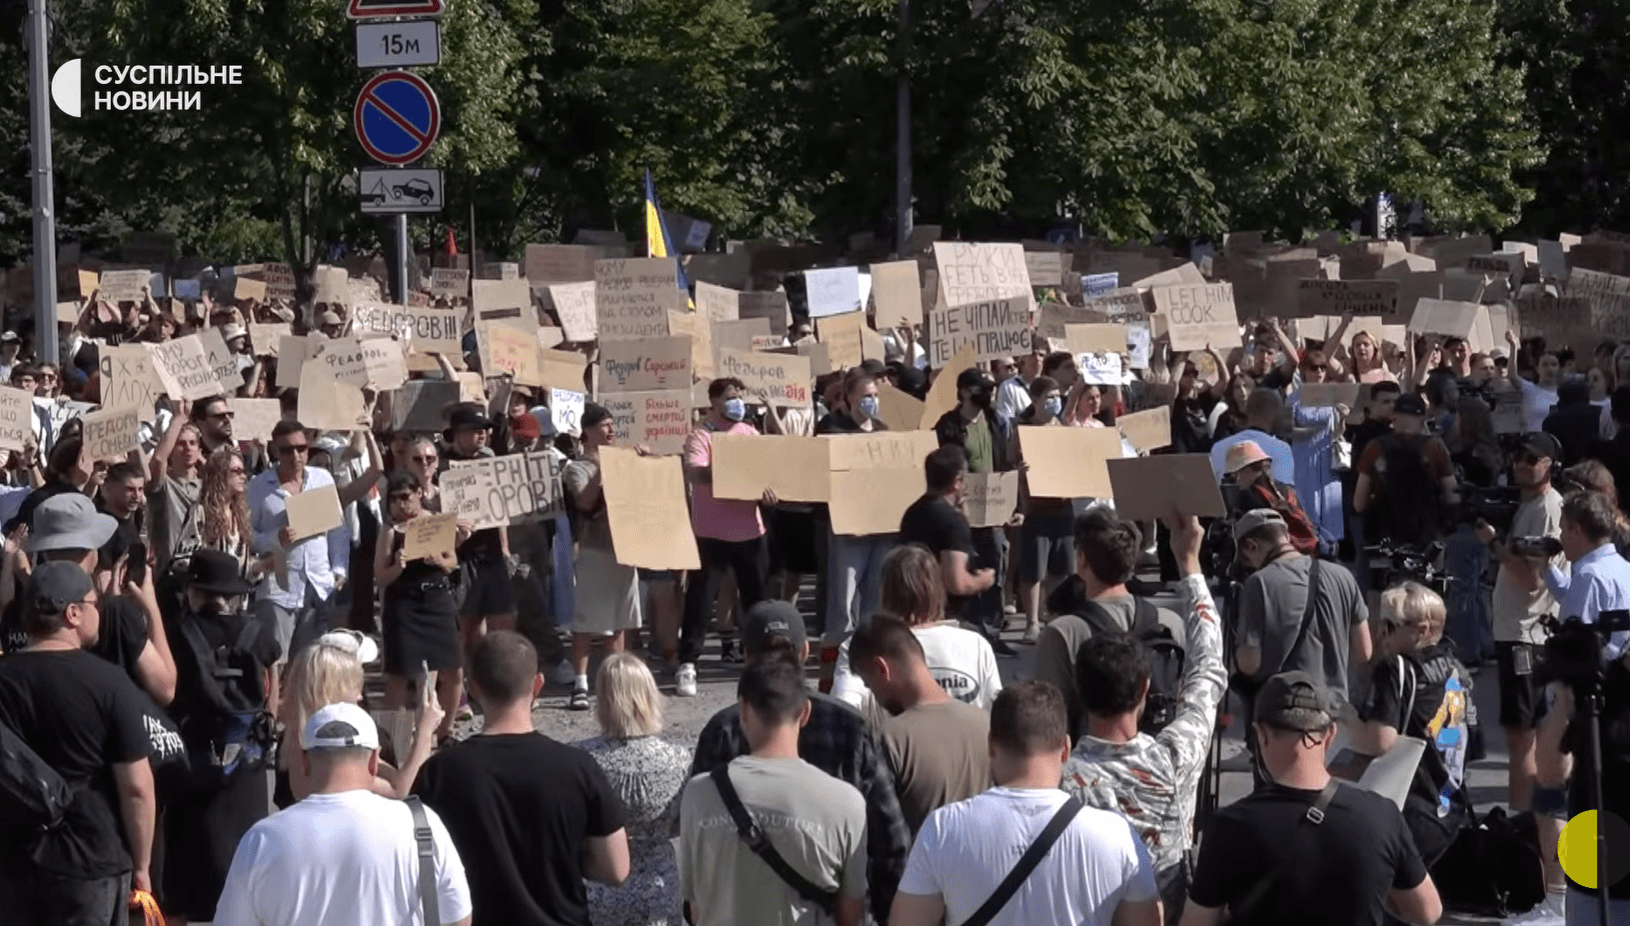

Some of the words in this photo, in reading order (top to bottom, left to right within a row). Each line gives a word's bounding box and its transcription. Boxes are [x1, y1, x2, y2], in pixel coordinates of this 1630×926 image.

[381, 34, 420, 55] 15м
[1168, 287, 1198, 306] LET
[1205, 285, 1232, 303] HIM
[935, 308, 960, 337] НЕ
[1170, 304, 1216, 324] COOK
[932, 339, 949, 364] ТЕ
[977, 328, 1030, 355] ПРАЦЮЄ
[645, 398, 680, 410] Більше
[645, 408, 686, 424] смертей
